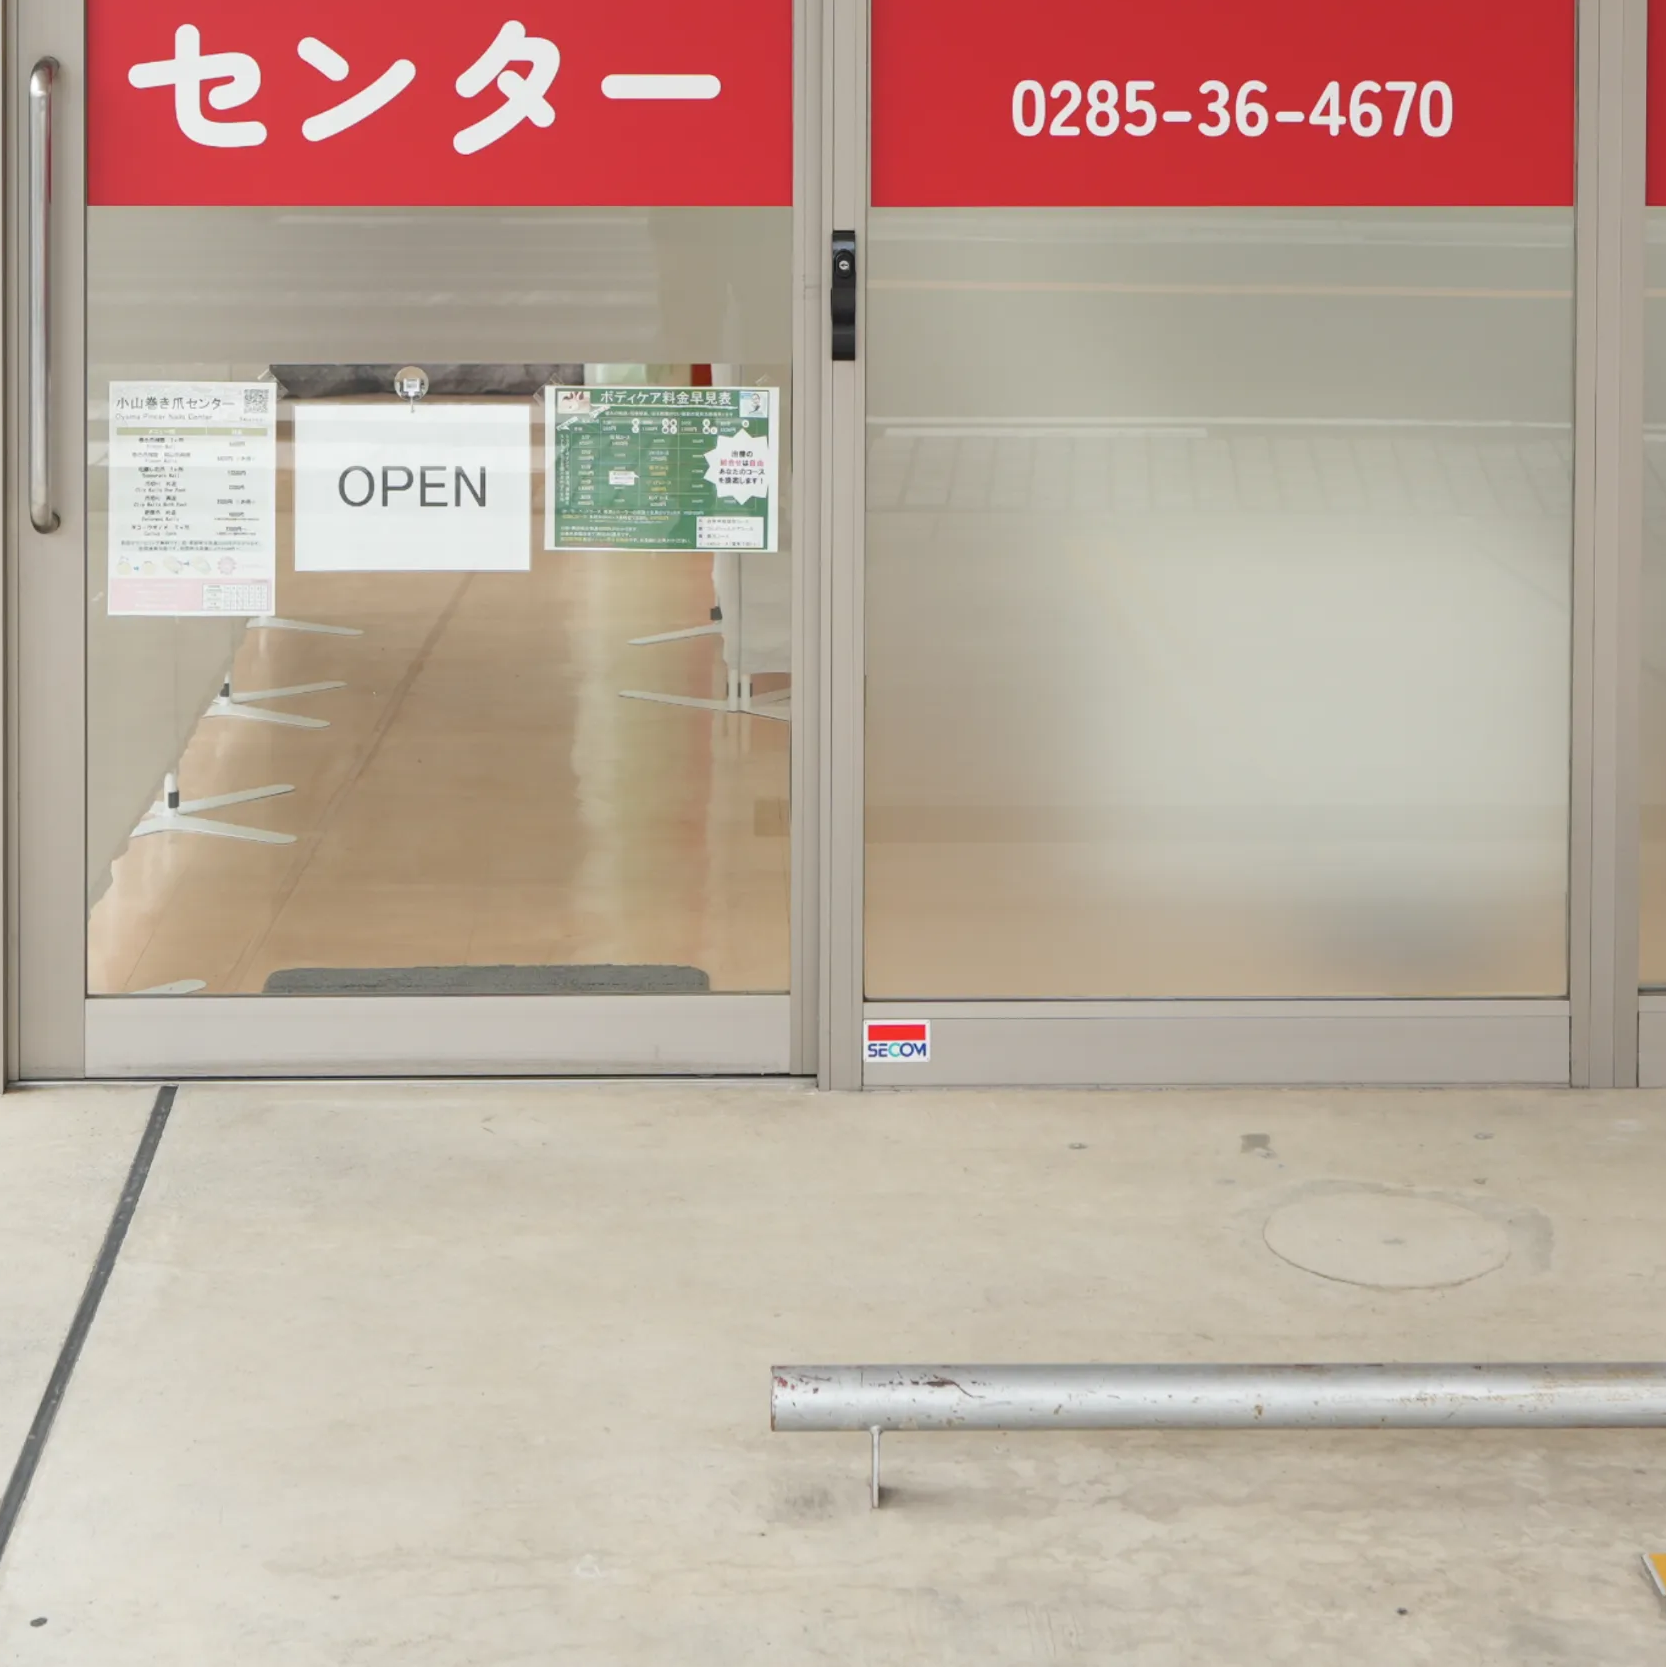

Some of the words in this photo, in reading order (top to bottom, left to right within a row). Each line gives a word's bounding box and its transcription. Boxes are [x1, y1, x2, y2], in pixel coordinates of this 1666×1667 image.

[127, 19, 722, 156] センター
[1012, 79, 1453, 138] 0285-36-4670
[116, 396, 235, 410] 小山巻き爪センター
[600, 390, 733, 406] ボディケア料金早見表
[337, 465, 487, 508] OPEN
[867, 1042, 927, 1058] SECOM
